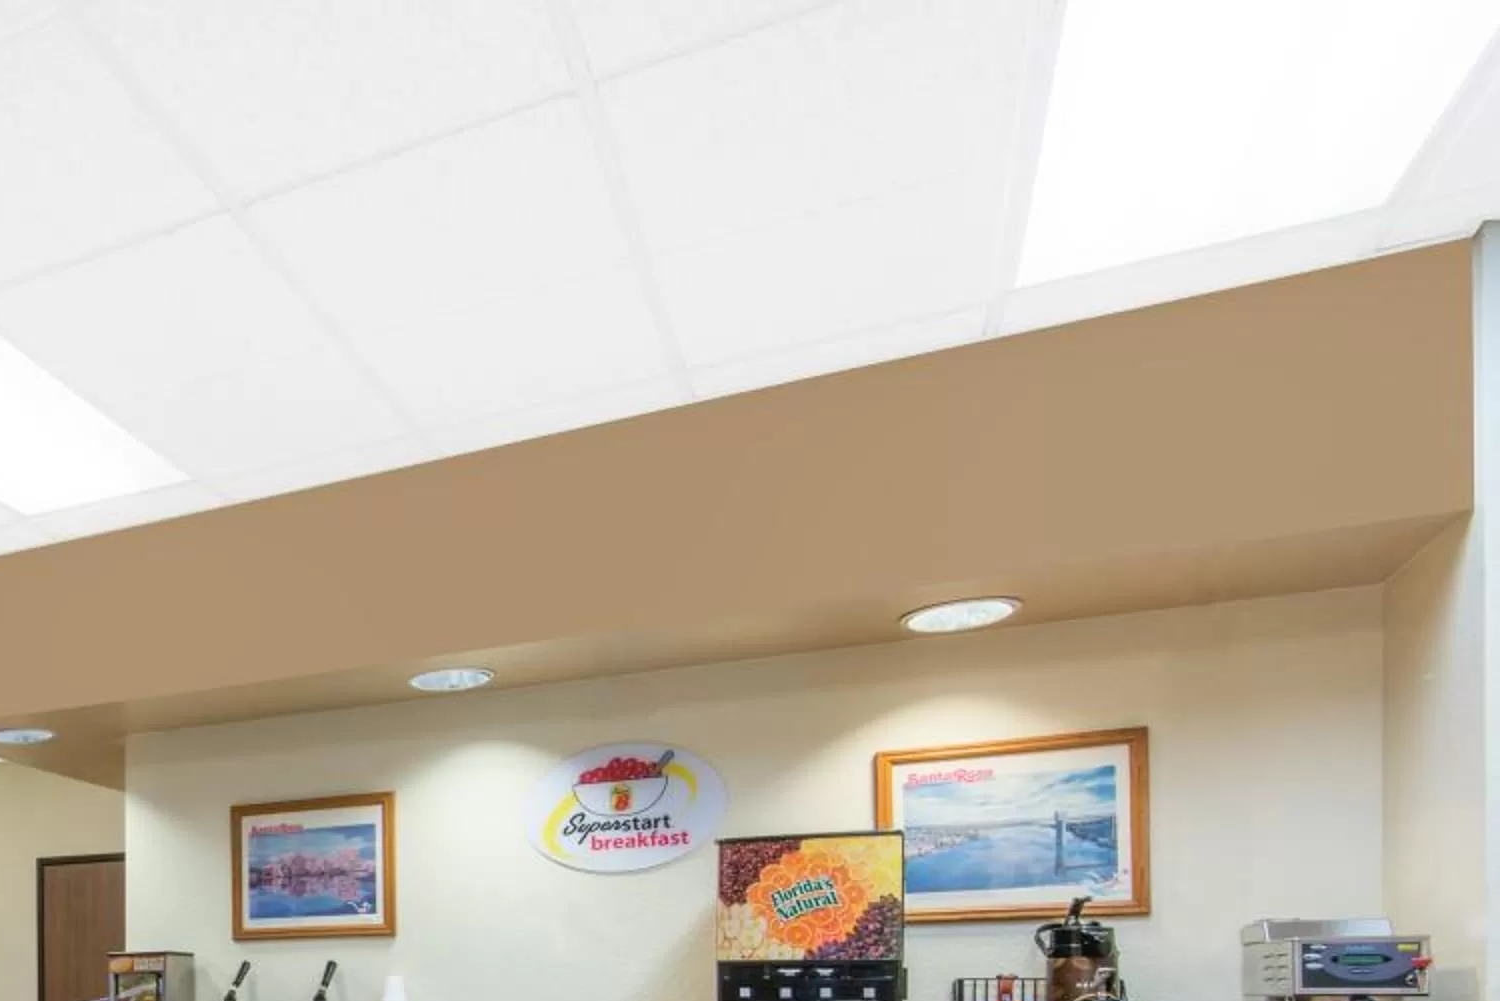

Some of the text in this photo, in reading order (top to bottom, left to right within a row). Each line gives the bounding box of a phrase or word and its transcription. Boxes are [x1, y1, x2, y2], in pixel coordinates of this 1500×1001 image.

[563, 812, 672, 845] Superstart
[591, 831, 690, 850] breakfast
[771, 879, 834, 908] Florida's
[777, 891, 839, 919] Natural
